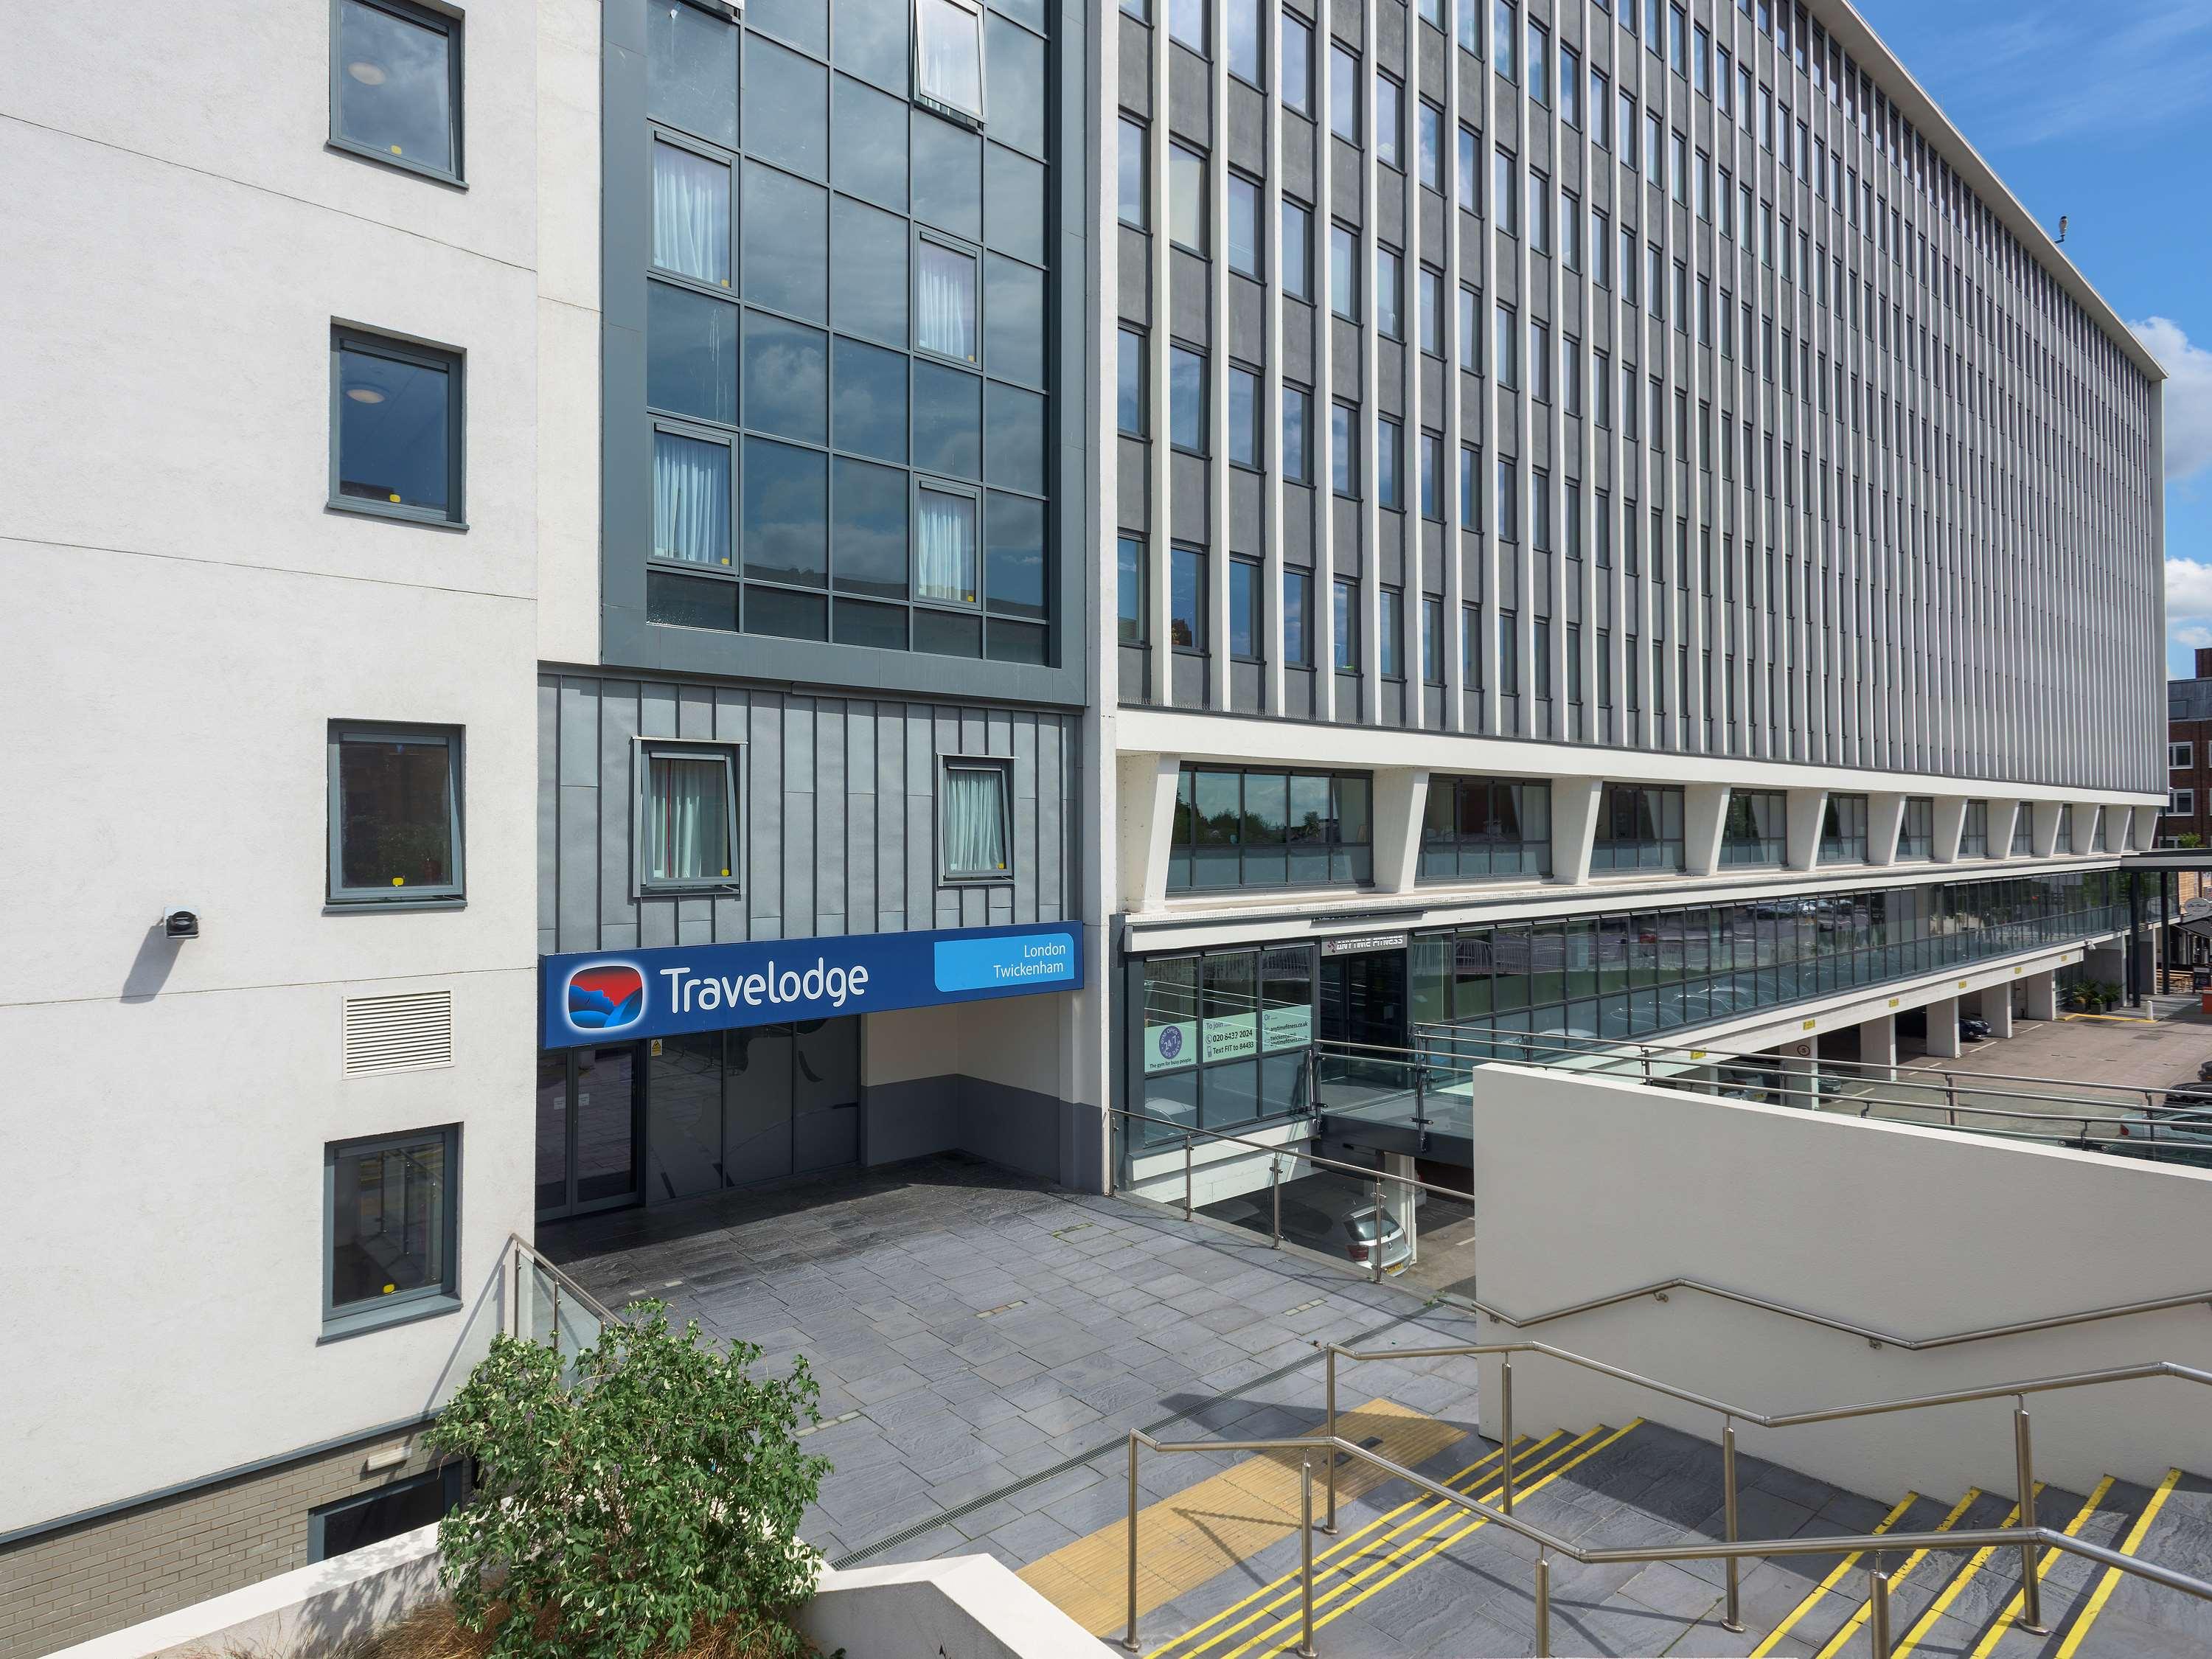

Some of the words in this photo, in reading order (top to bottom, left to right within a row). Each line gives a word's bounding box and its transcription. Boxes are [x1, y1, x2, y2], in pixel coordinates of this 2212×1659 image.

[1023, 942, 1065, 958] London
[1336, 939, 1371, 950] ANYTIME
[1372, 935, 1403, 947] FITNESS
[992, 961, 1064, 978] Twickenham
[659, 957, 869, 1014] Travelodge
[1270, 1020, 1309, 1032] anytimefitness.co.uk
[1212, 1034, 1224, 1042] 020
[1224, 1032, 1239, 1040] 8432
[1239, 1029, 1253, 1038] 2024
[1212, 1046, 1225, 1054] Text
[1224, 1044, 1233, 1052] FIT
[1239, 1041, 1254, 1050] 84433
